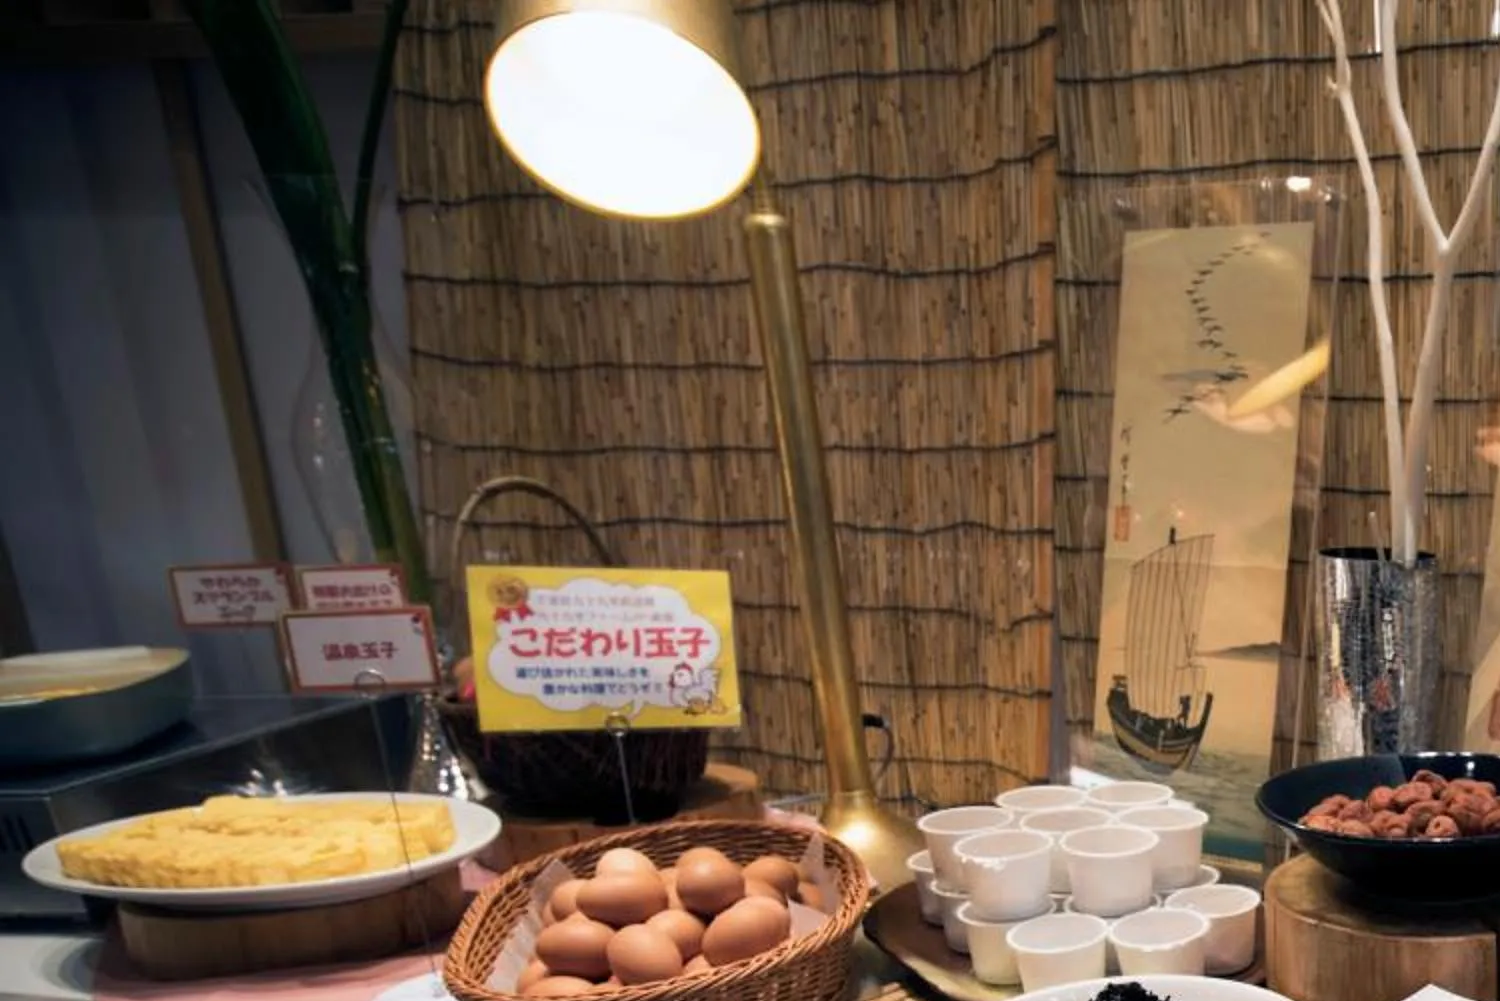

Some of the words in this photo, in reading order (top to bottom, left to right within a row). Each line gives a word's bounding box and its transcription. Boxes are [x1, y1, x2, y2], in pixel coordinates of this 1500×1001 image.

[323, 642, 398, 661] 温泉玉子
[509, 626, 711, 659] こだわり玉子
